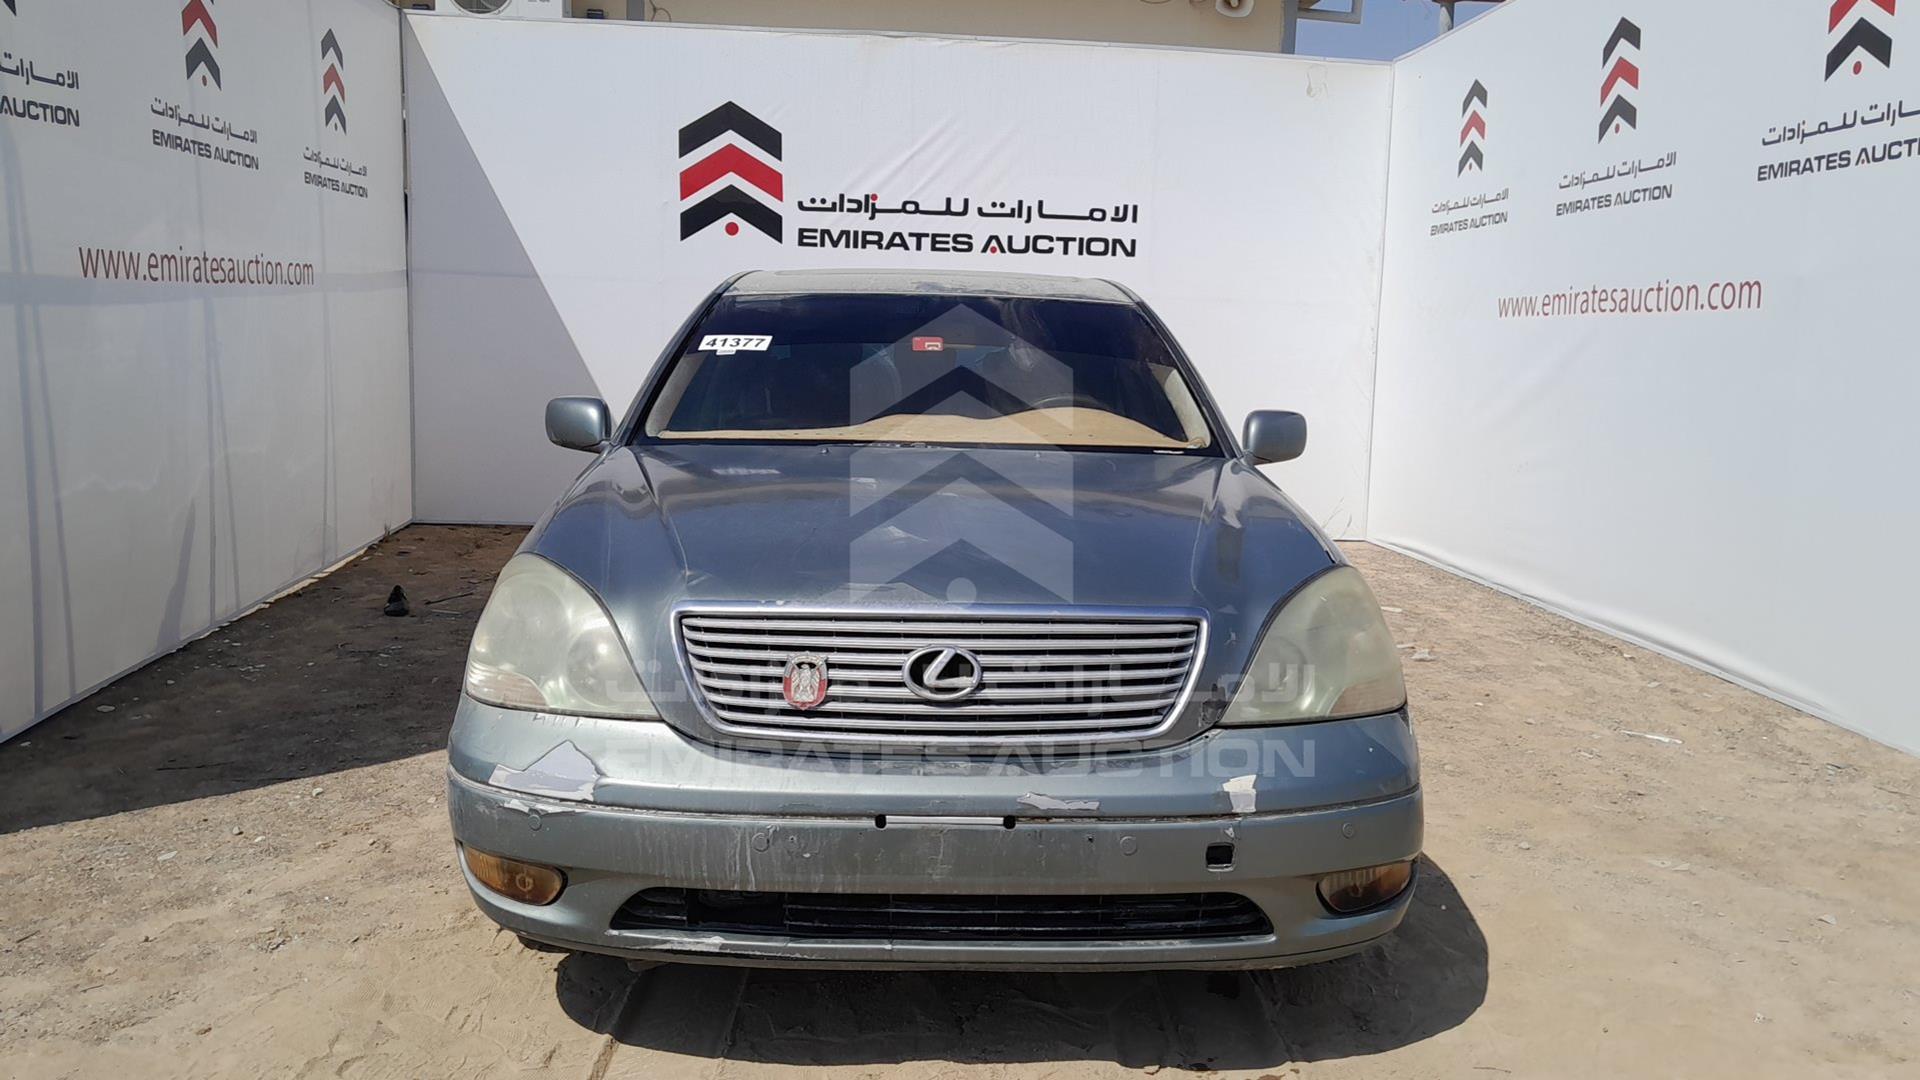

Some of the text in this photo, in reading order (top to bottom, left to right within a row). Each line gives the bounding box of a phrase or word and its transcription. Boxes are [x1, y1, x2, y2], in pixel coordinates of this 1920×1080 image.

[0, 95, 80, 127] AUCTION
[1861, 100, 1920, 126] ارات
[152, 129, 259, 170] EMIRATES AUCTION
[1757, 137, 1920, 181] EMIRATES AUCTI
[304, 171, 368, 198] EMIRATES AUCTION
[1556, 184, 1673, 216] EMIRATES AUCTION
[977, 199, 1138, 224] الامارات
[1430, 211, 1508, 236] EMIRATES AUCTION
[797, 227, 1137, 258] EMIRATES AUCTION
[79, 246, 315, 286] www.emiratesauction.com
[1498, 278, 1763, 318] www.emiratesauction.com
[705, 337, 767, 348] 41377
